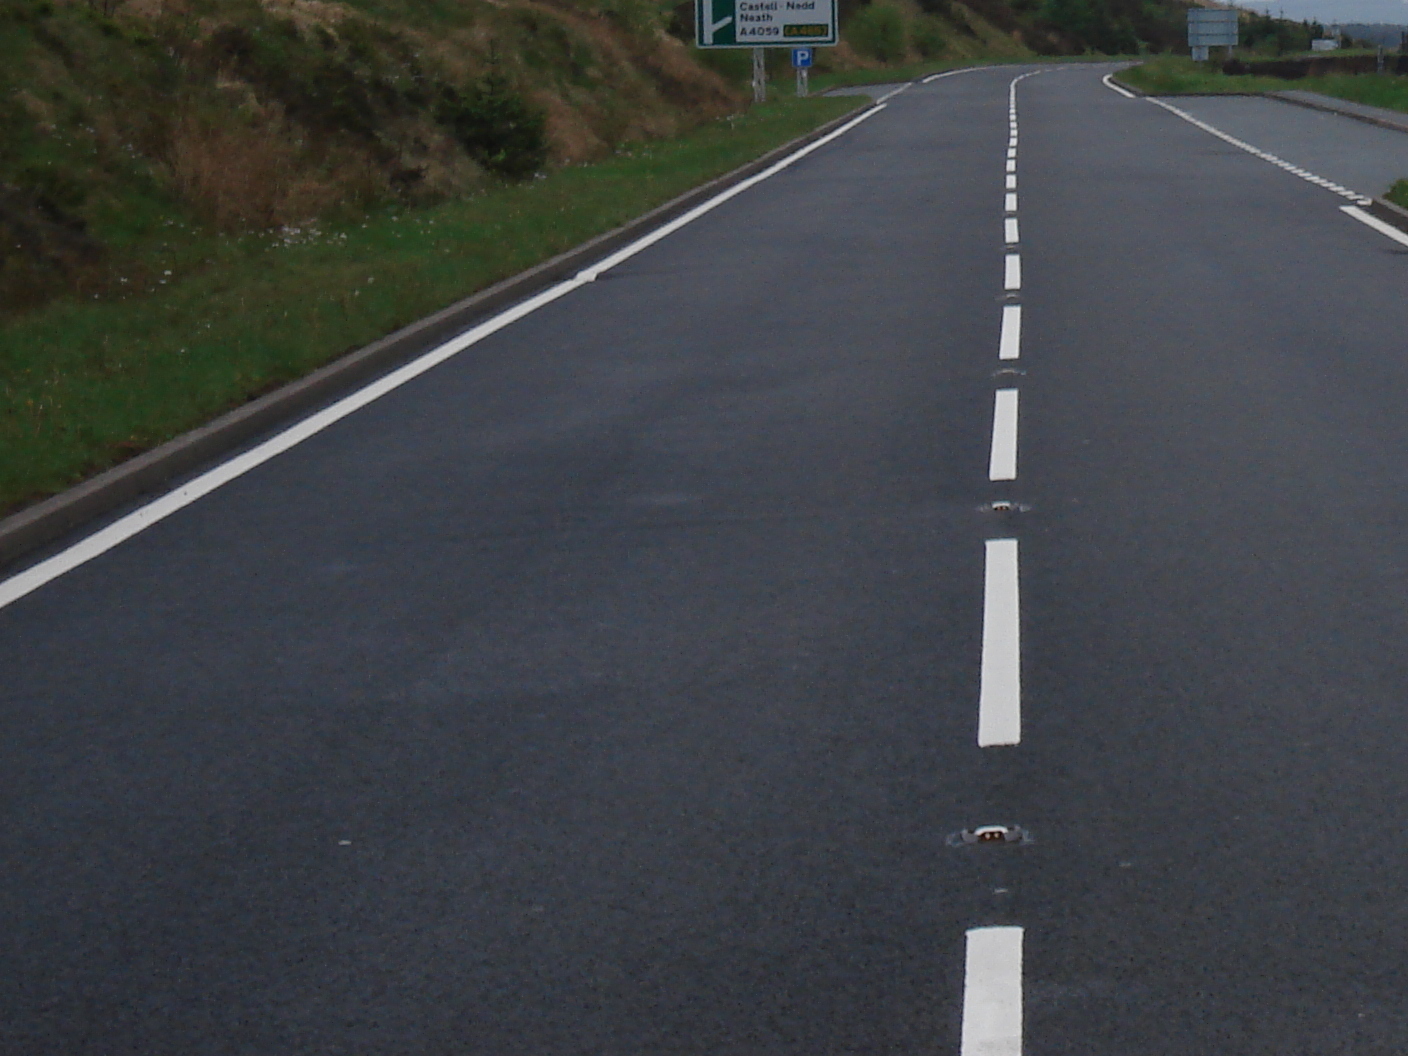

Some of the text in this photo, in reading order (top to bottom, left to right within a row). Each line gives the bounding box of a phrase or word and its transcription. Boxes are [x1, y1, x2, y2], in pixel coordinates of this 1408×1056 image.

[740, 2, 778, 11] Castell
[786, 2, 815, 10] Nedd
[740, 14, 773, 22] Neath
[740, 27, 779, 36] A4059
[797, 51, 809, 66] P
